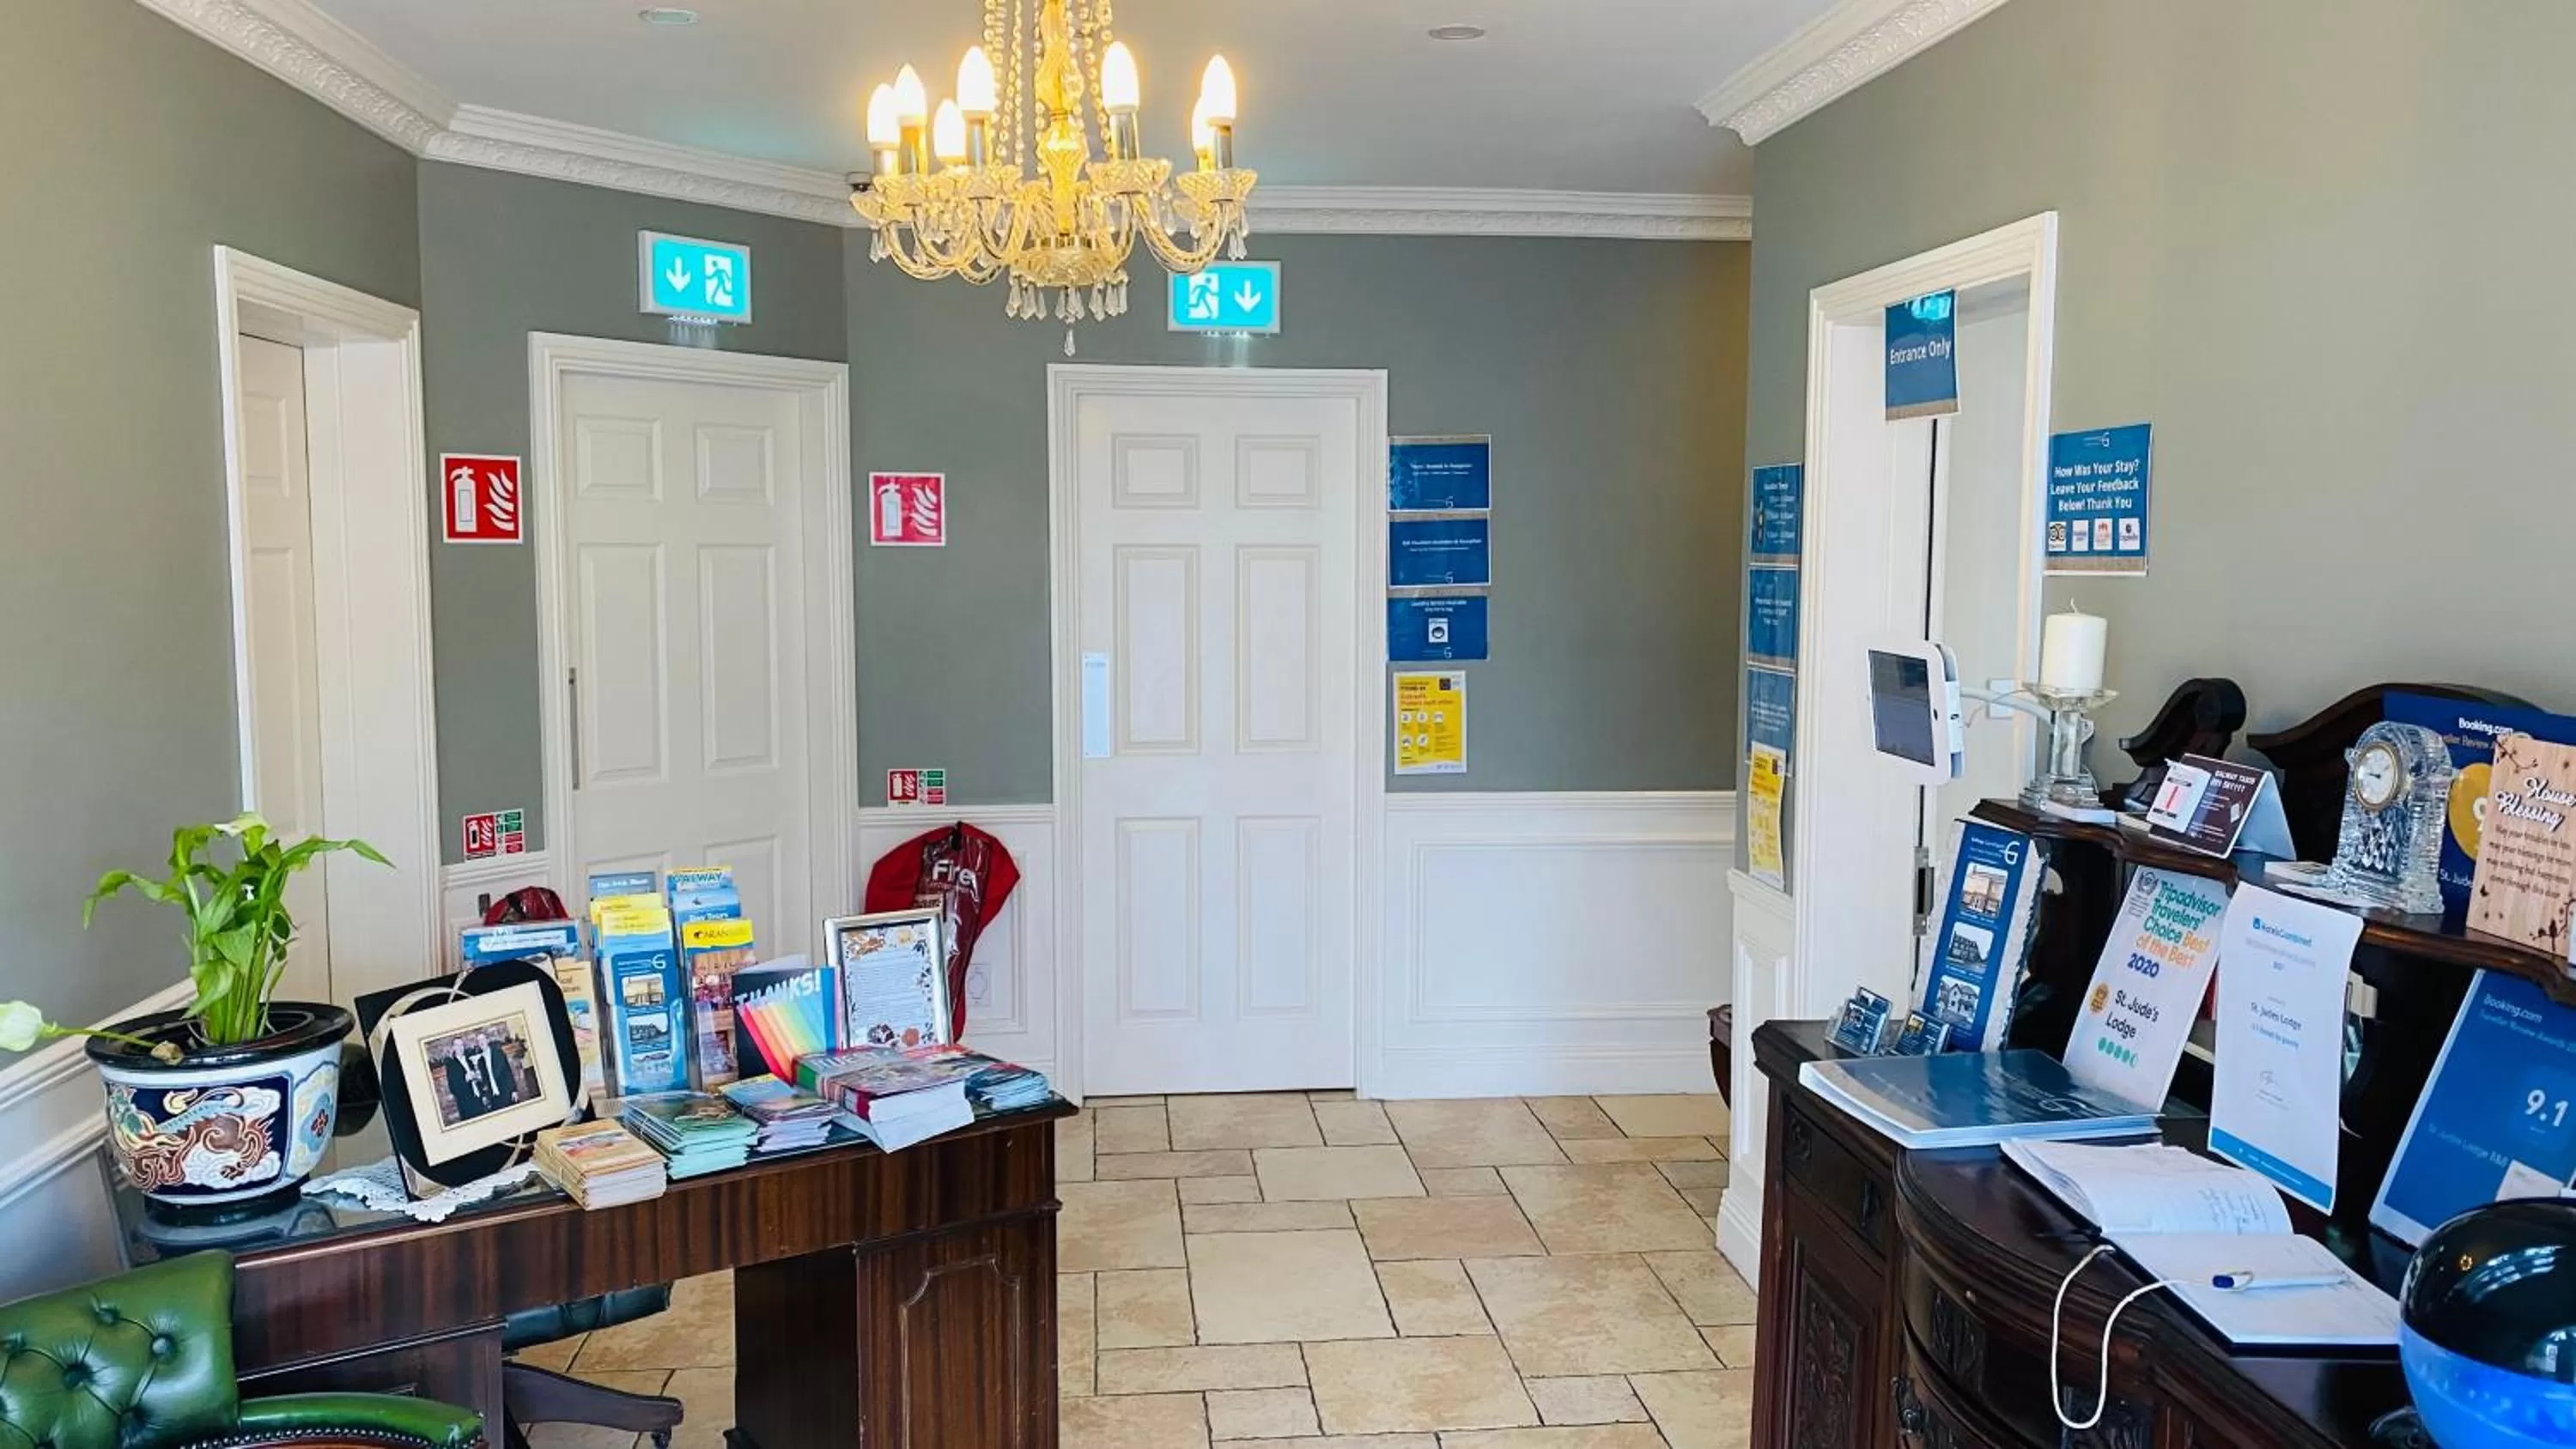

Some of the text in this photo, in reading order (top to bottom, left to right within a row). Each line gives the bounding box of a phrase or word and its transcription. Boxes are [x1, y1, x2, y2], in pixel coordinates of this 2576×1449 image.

[1890, 336, 1951, 365] Entrance Only
[2053, 458, 2140, 478] How Was Your Stay?
[2050, 477, 2139, 495] Leave Your Feedback
[2087, 497, 2112, 510] Thank
[2114, 496, 2132, 509] You
[2458, 718, 2513, 735] Booking.com
[2524, 777, 2576, 808] House
[2494, 791, 2565, 833] Blessing
[932, 859, 971, 885] Fire
[2160, 879, 2221, 917] Tripadvisor
[2143, 915, 2210, 953] Choice Best
[2127, 952, 2160, 978] 2020
[2136, 934, 2196, 968] of the Best
[734, 968, 821, 1009] THANKS!
[2127, 997, 2160, 1023] Jude's
[2483, 993, 2543, 1024] Booking.com
[2105, 1011, 2136, 1040] Lodge
[2524, 1089, 2569, 1127] 9.1
